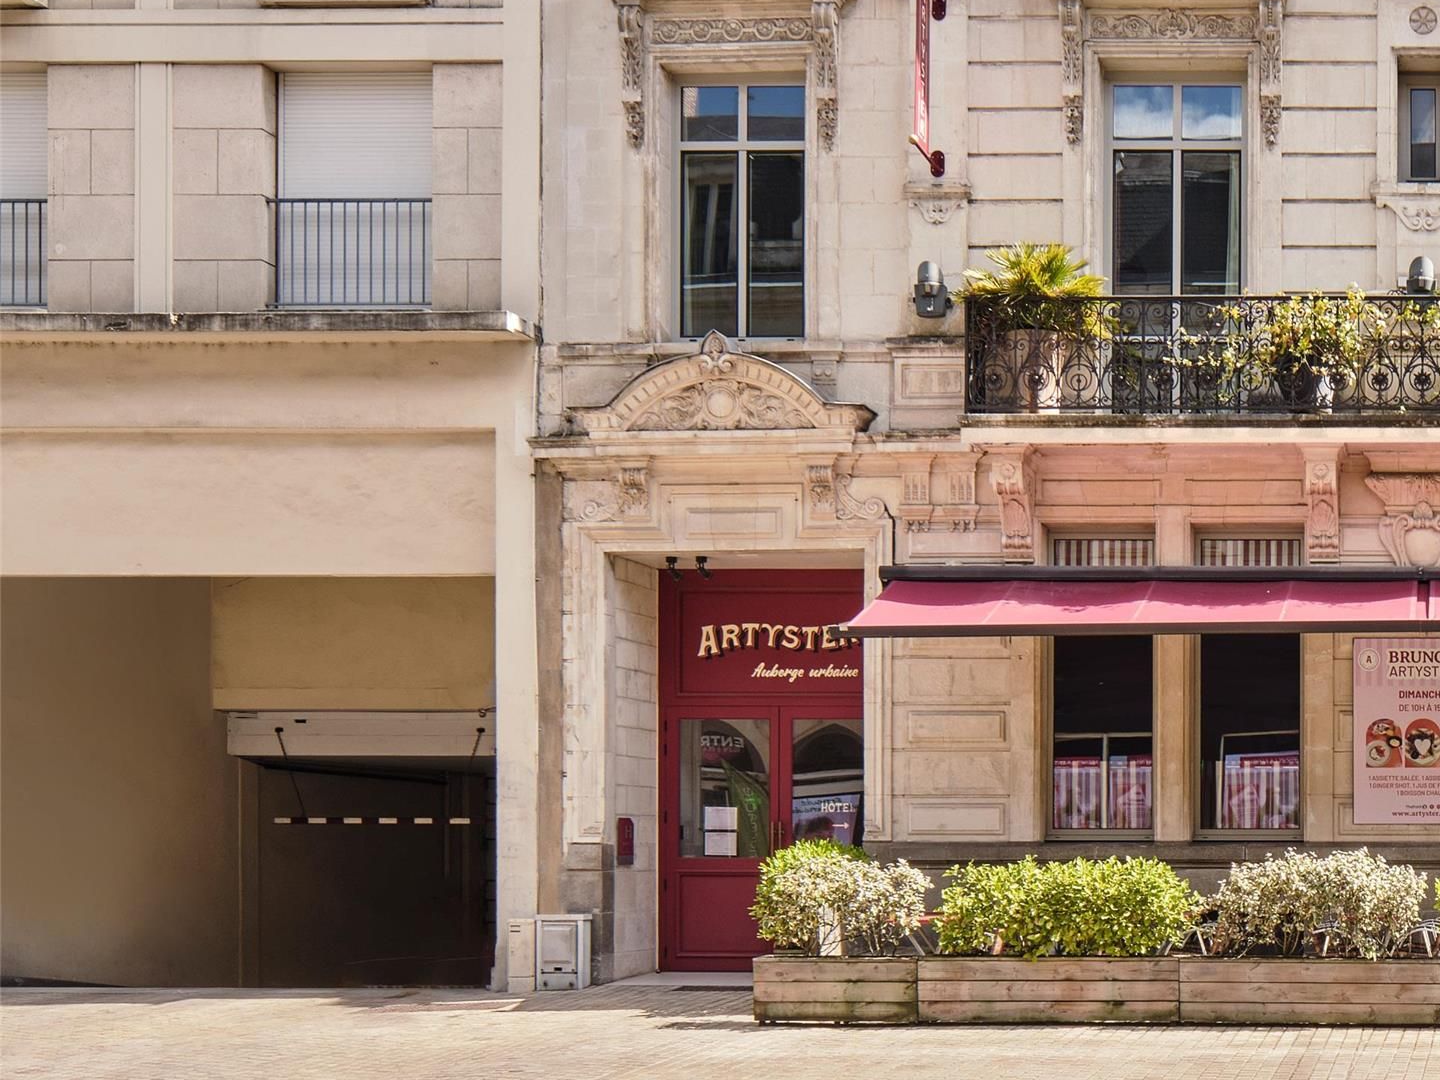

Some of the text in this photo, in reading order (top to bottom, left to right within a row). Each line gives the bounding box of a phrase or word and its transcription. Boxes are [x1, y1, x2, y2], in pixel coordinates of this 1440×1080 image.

[751, 662, 859, 683] Auberge urbaine
[1398, 704, 1409, 712] DE
[1411, 704, 1425, 712] 10H
